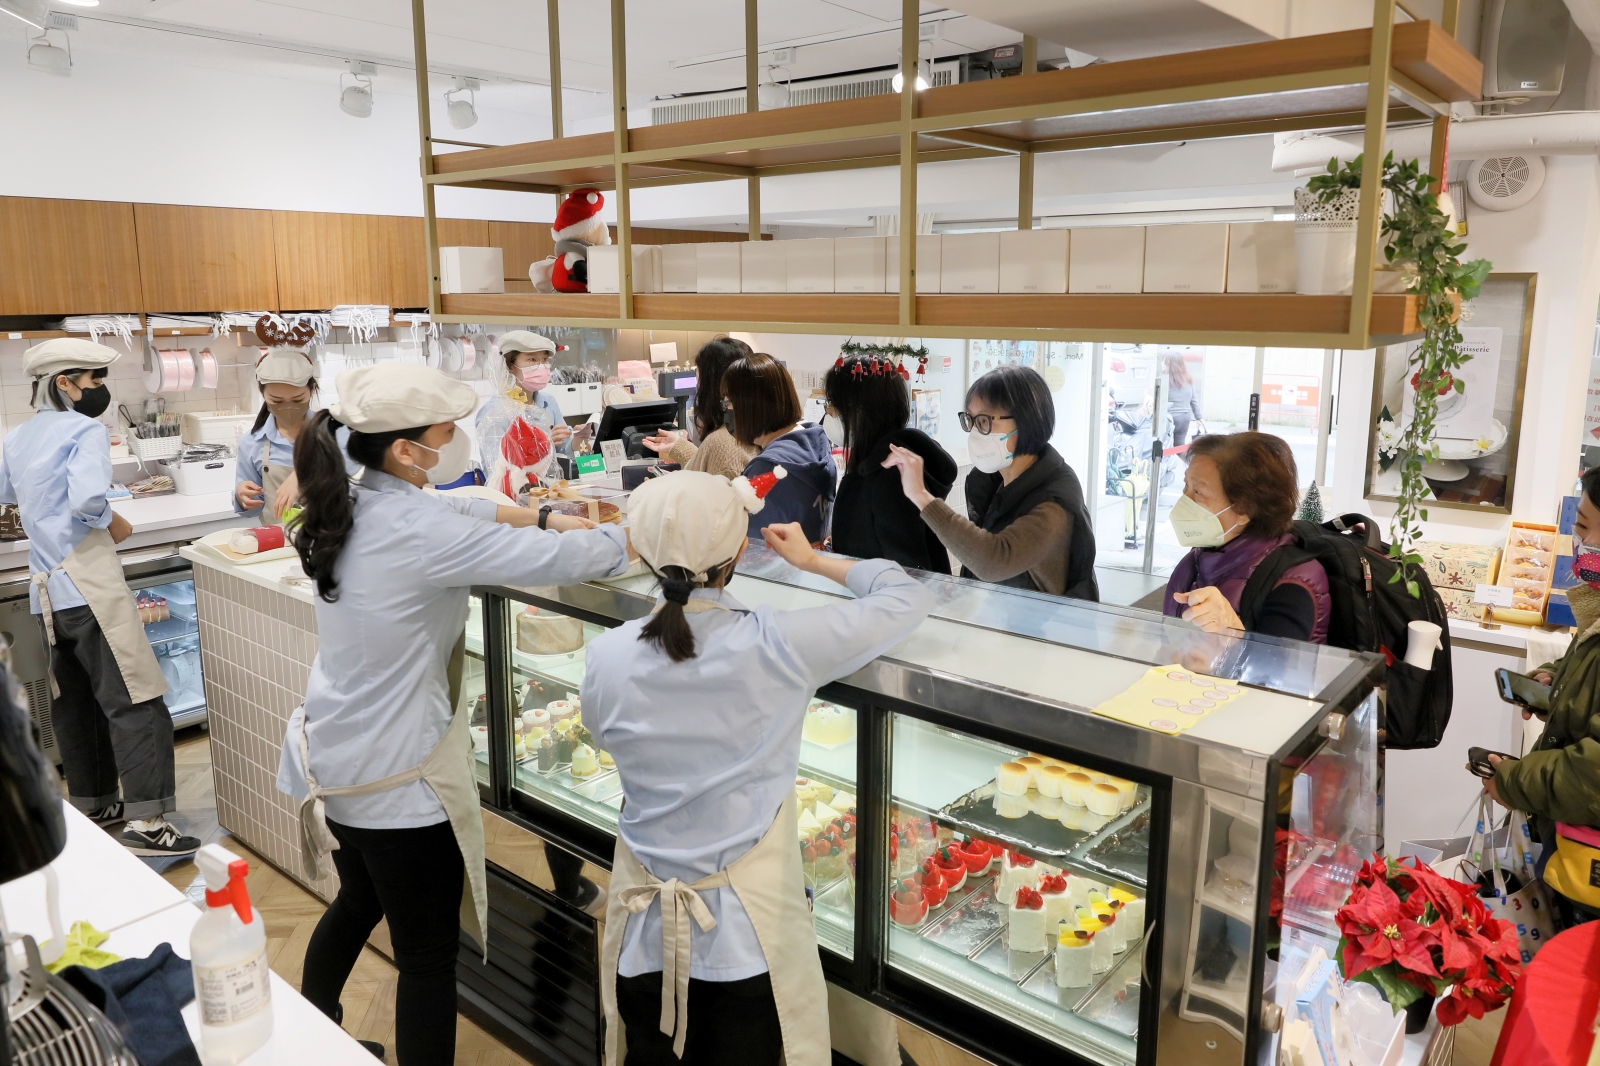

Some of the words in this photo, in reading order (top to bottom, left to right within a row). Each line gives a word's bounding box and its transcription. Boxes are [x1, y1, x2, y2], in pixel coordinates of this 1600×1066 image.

[157, 831, 176, 848] N
[1512, 897, 1522, 911] 3
[1516, 923, 1527, 936] 5
[1530, 928, 1540, 940] 9
